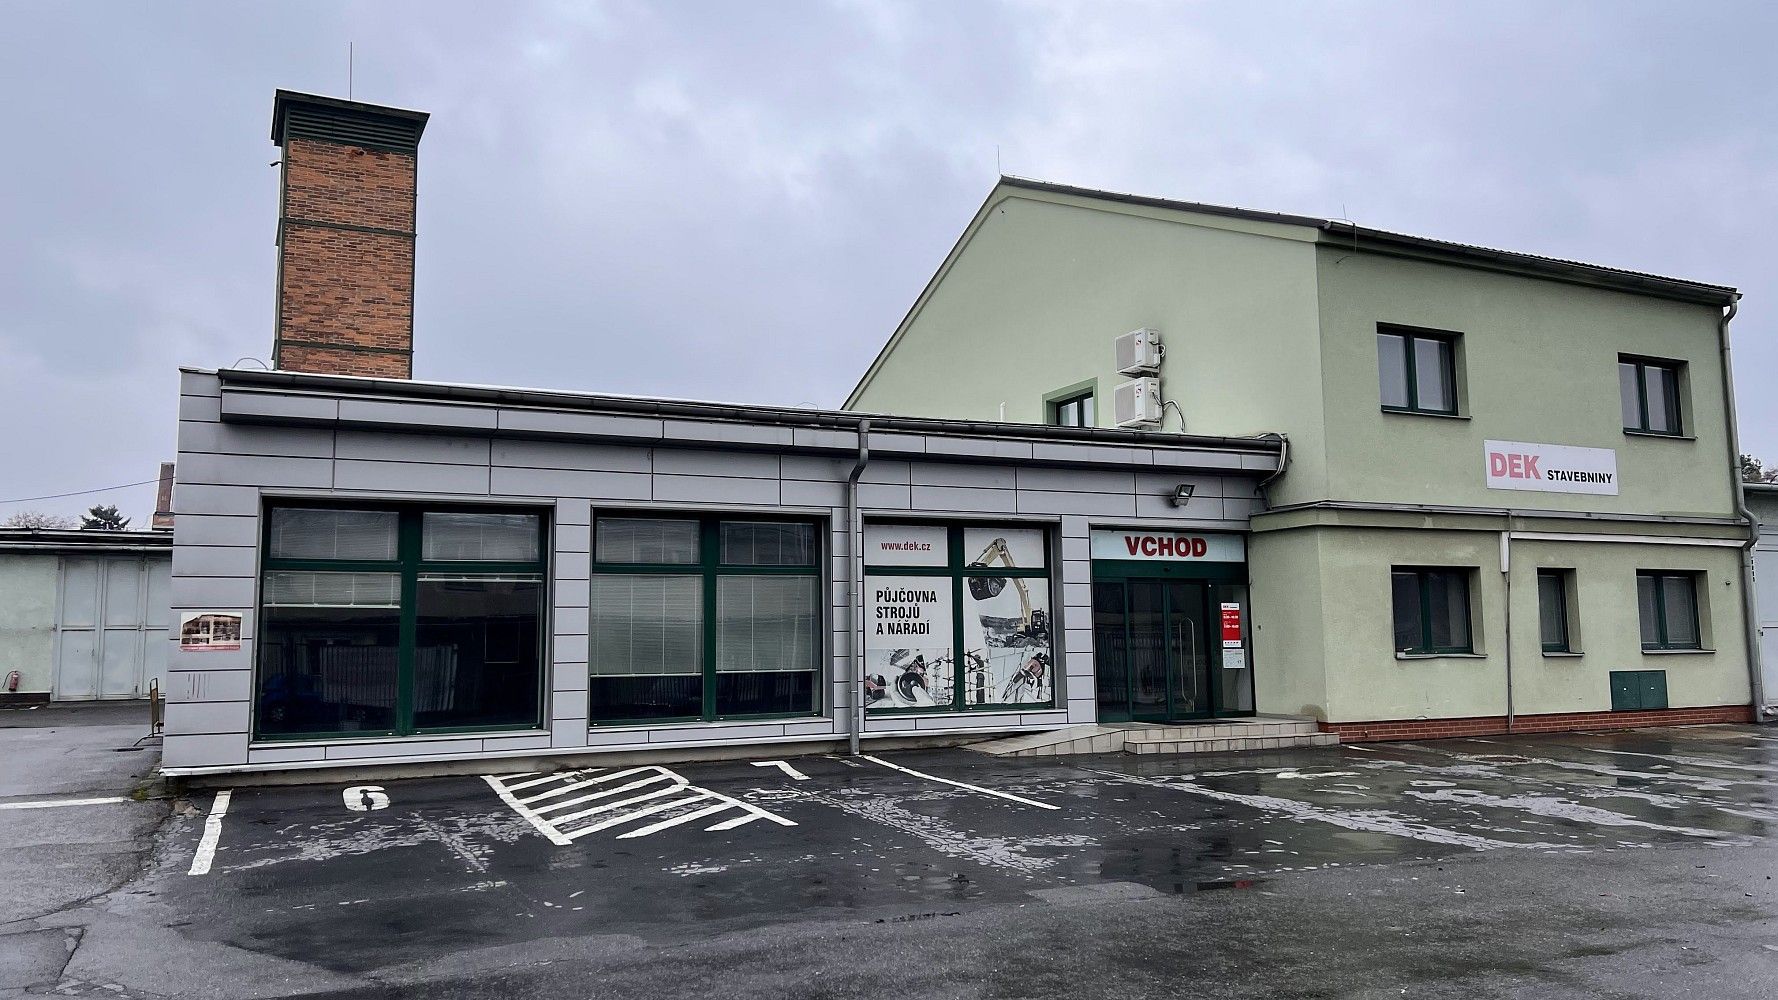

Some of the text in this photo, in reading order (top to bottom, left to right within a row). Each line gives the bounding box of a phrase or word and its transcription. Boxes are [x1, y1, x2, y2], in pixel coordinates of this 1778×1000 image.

[1490, 452, 1612, 484] DEK STAVEBNINY
[881, 541, 931, 551] www.dek.cz
[1125, 536, 1208, 557] VCHOD
[876, 586, 937, 603] PŮJČOVNA
[876, 603, 920, 619] STROJŮ
[876, 619, 930, 635] A NÁŘADÍ
[343, 785, 390, 811] 6
